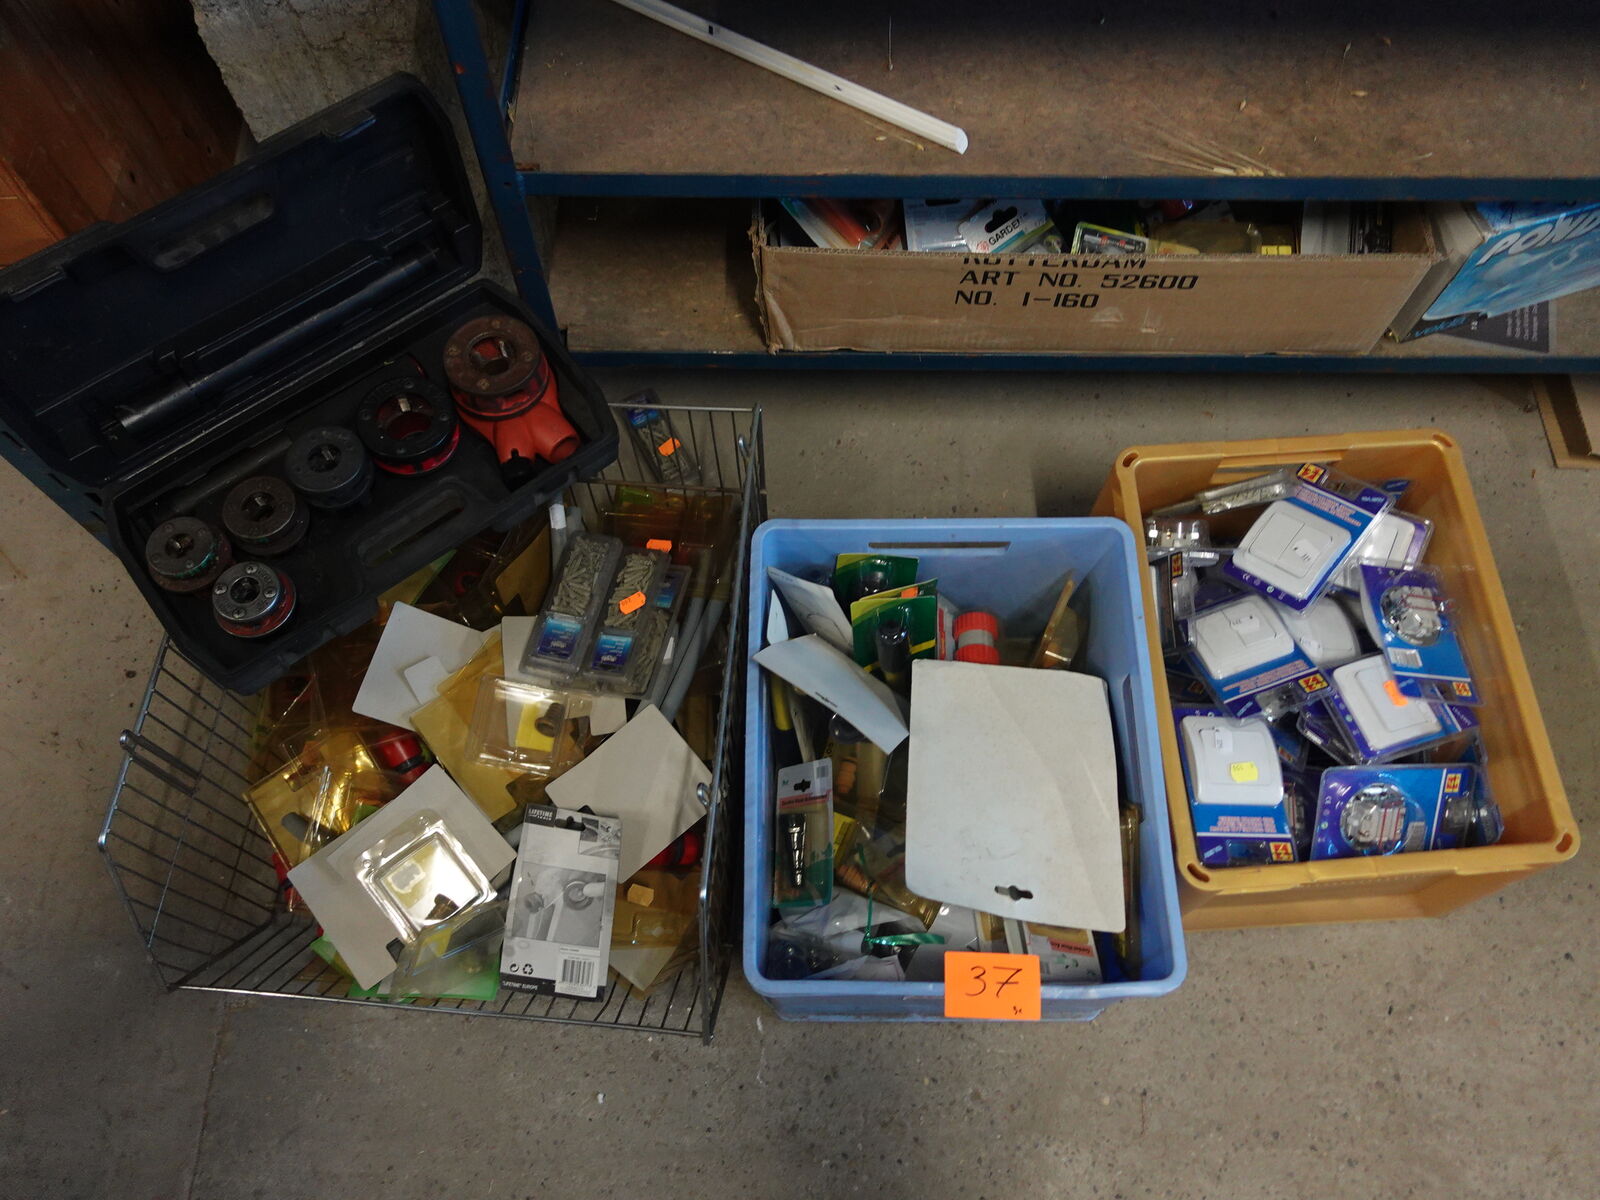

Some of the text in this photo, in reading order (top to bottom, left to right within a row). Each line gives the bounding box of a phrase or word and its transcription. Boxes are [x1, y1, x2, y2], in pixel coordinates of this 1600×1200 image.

[960, 271, 1199, 289] ART NO. 52600
[955, 291, 997, 306] NO.
[965, 966, 1022, 998] 37
